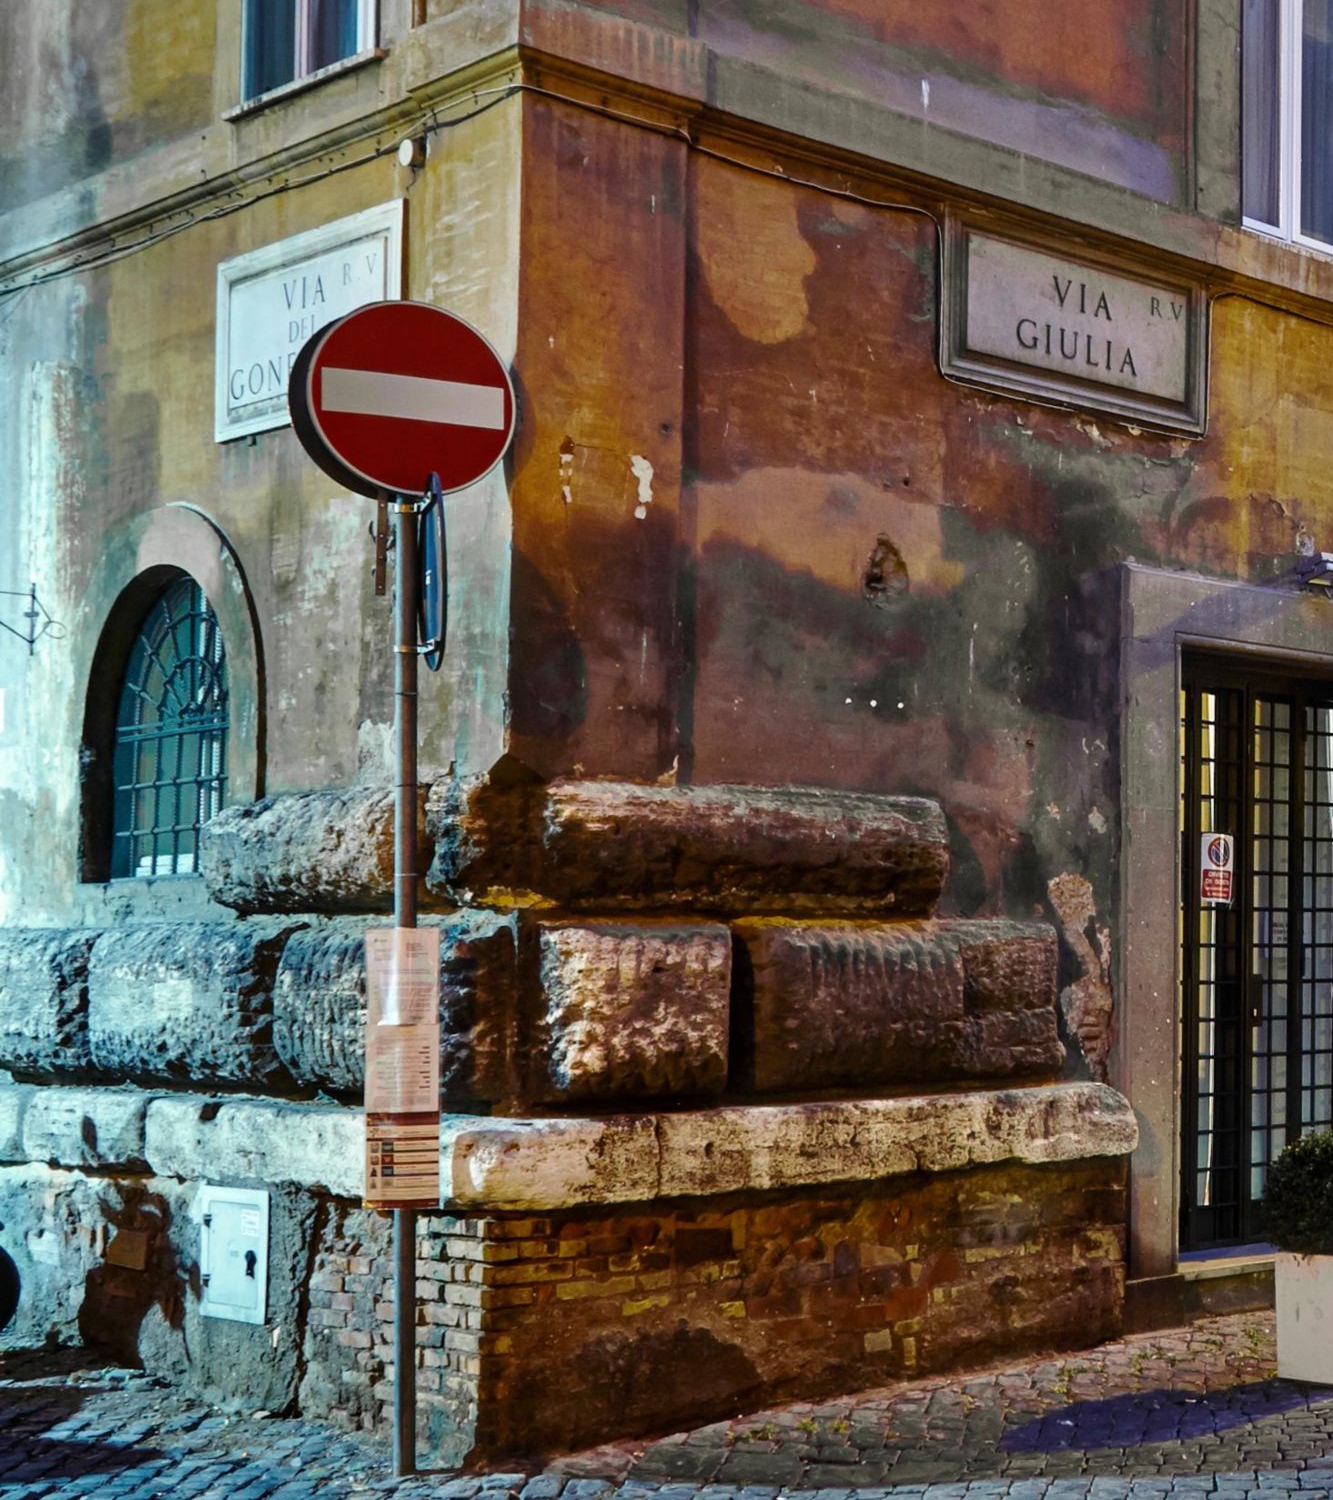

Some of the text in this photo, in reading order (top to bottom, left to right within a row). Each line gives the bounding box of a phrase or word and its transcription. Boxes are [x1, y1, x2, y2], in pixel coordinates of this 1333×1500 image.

[283, 274, 326, 311] VIA
[1052, 274, 1113, 322] VIA
[1016, 318, 1138, 378] GIULIA
